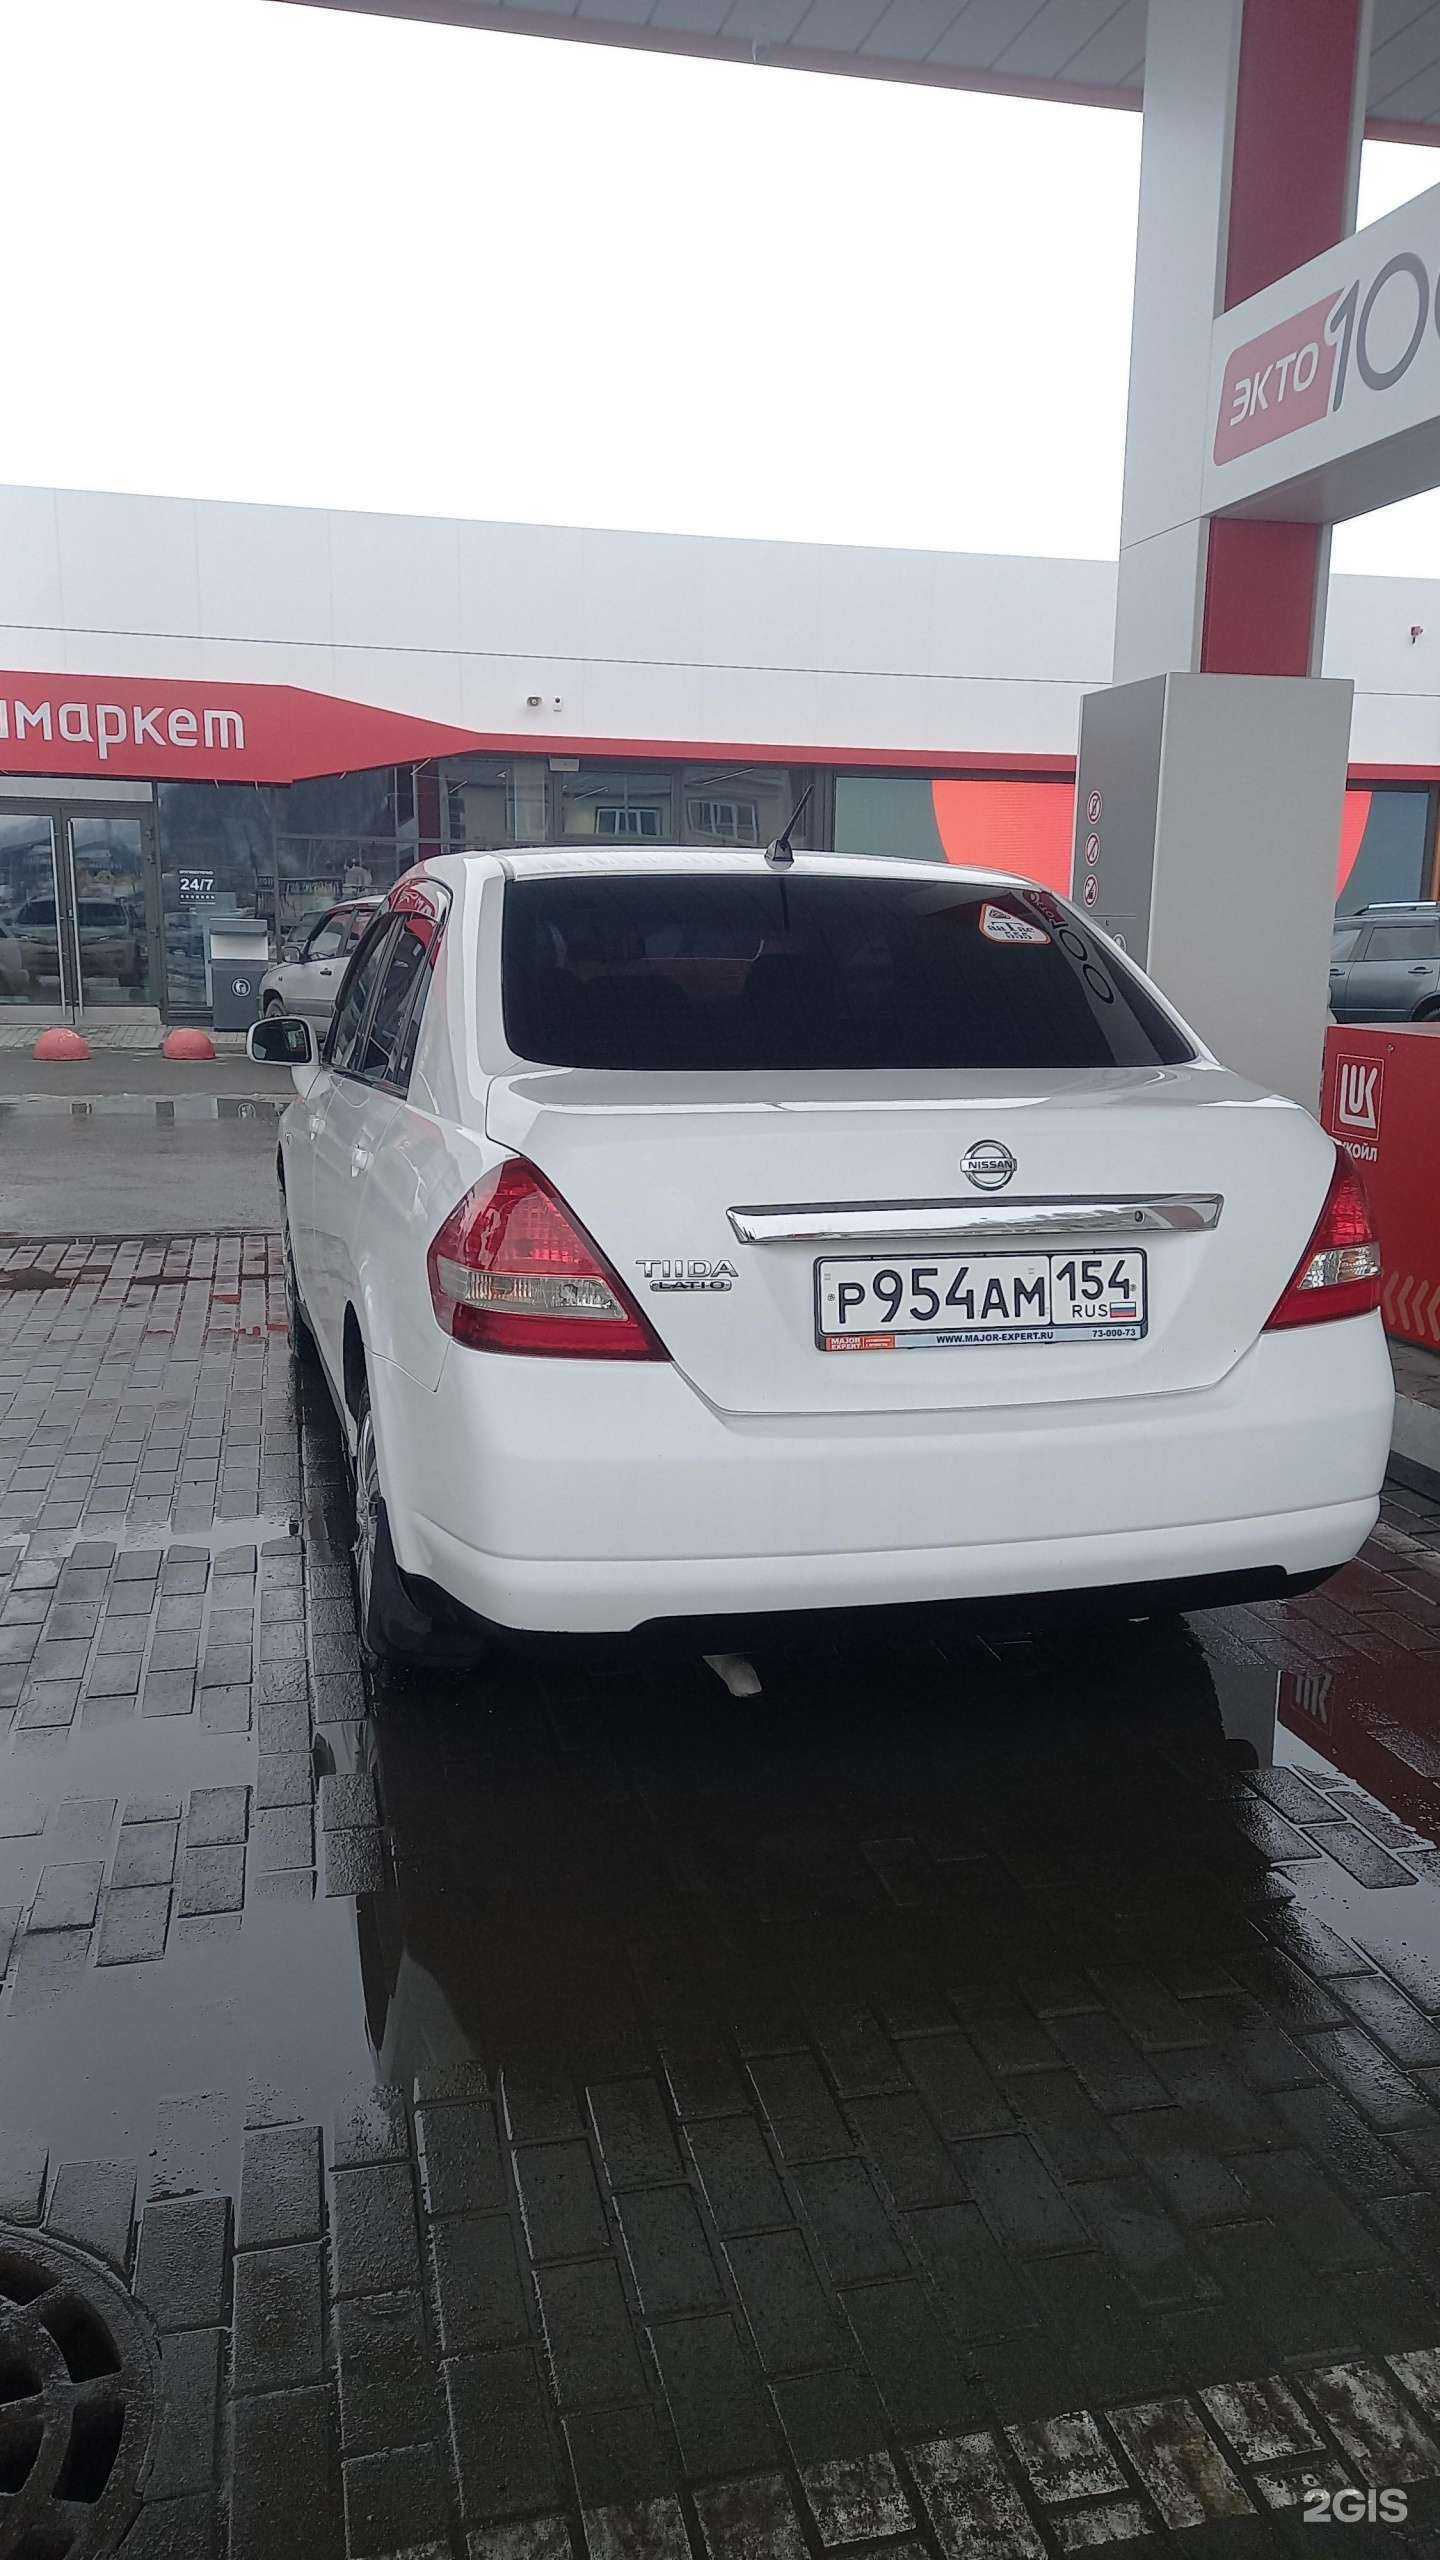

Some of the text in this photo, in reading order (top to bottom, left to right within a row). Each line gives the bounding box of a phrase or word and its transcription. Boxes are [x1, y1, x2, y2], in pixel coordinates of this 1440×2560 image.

[1230, 252, 1440, 426] ЭКТО 10
[0, 699, 245, 760] маркет
[180, 878, 214, 891] 24/7
[968, 1160, 1013, 1169] NISSAN
[635, 1259, 739, 1278] TIIDA
[659, 1281, 726, 1289] LATIO
[1056, 1259, 1131, 1301] 154
[1072, 1303, 1108, 1318] RUS
[936, 1328, 1136, 1344] WWW.MAJOR-EXPERT.RU 73-000-73
